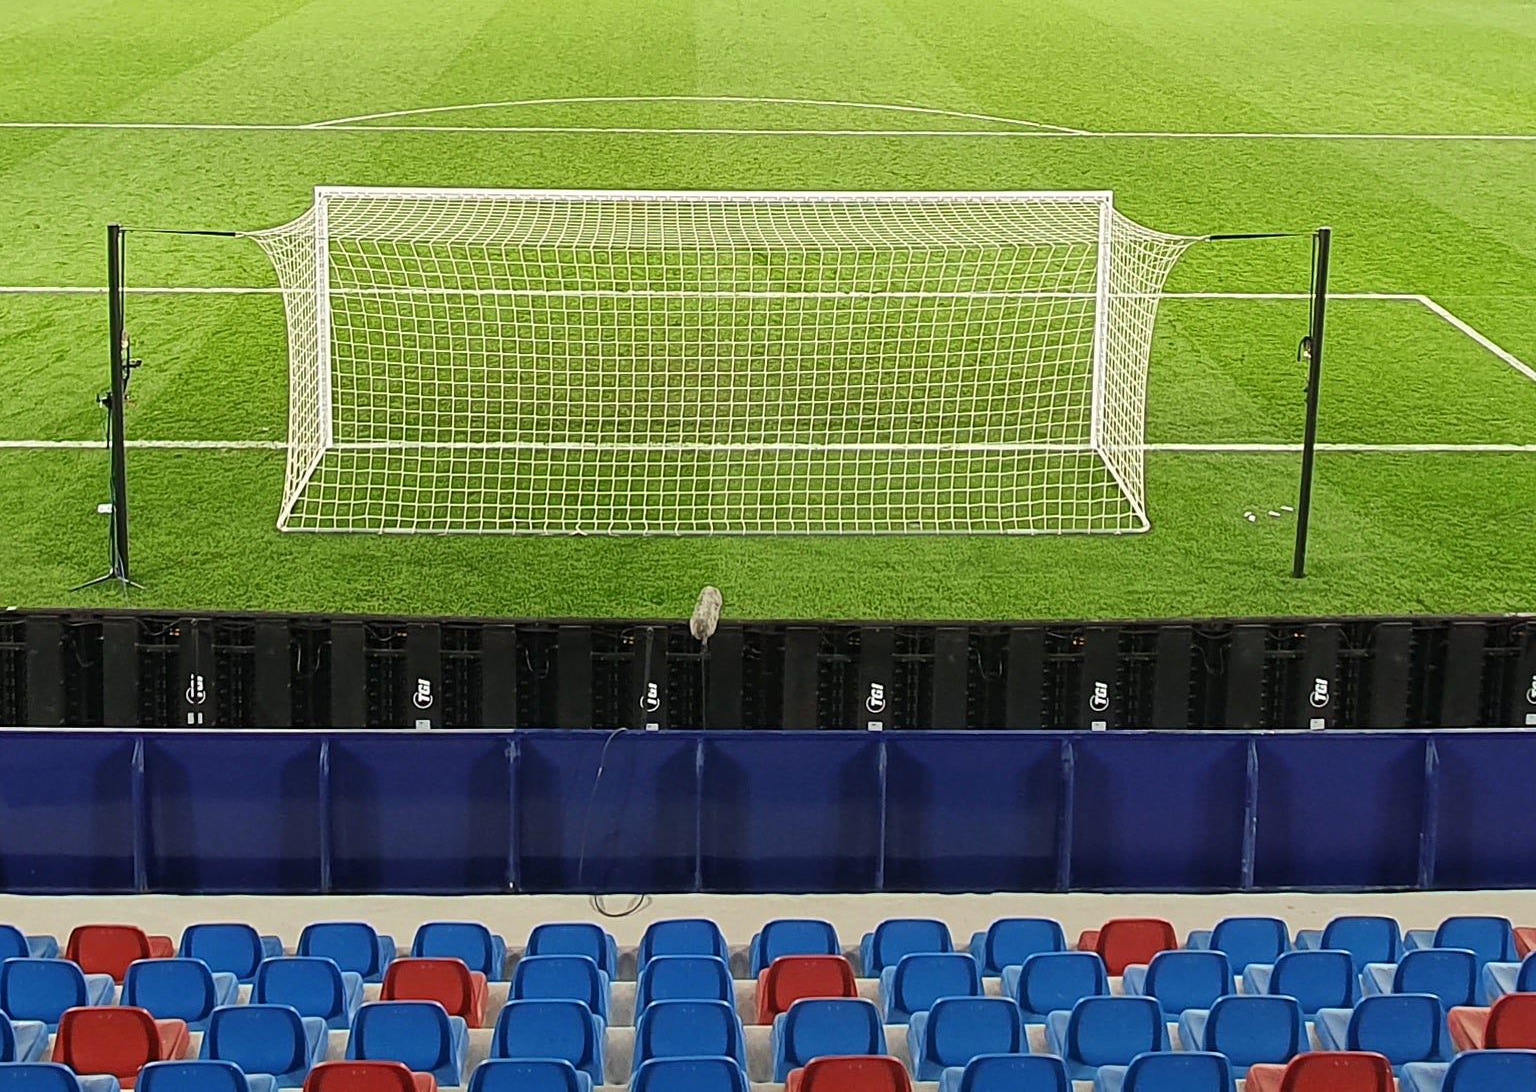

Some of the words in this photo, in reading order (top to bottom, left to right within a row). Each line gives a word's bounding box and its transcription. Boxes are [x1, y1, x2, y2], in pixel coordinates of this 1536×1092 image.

[416, 678, 431, 702] TGI
[869, 683, 884, 707] TGI
[1093, 681, 1108, 705] TGI
[1313, 678, 1329, 702] TGI
